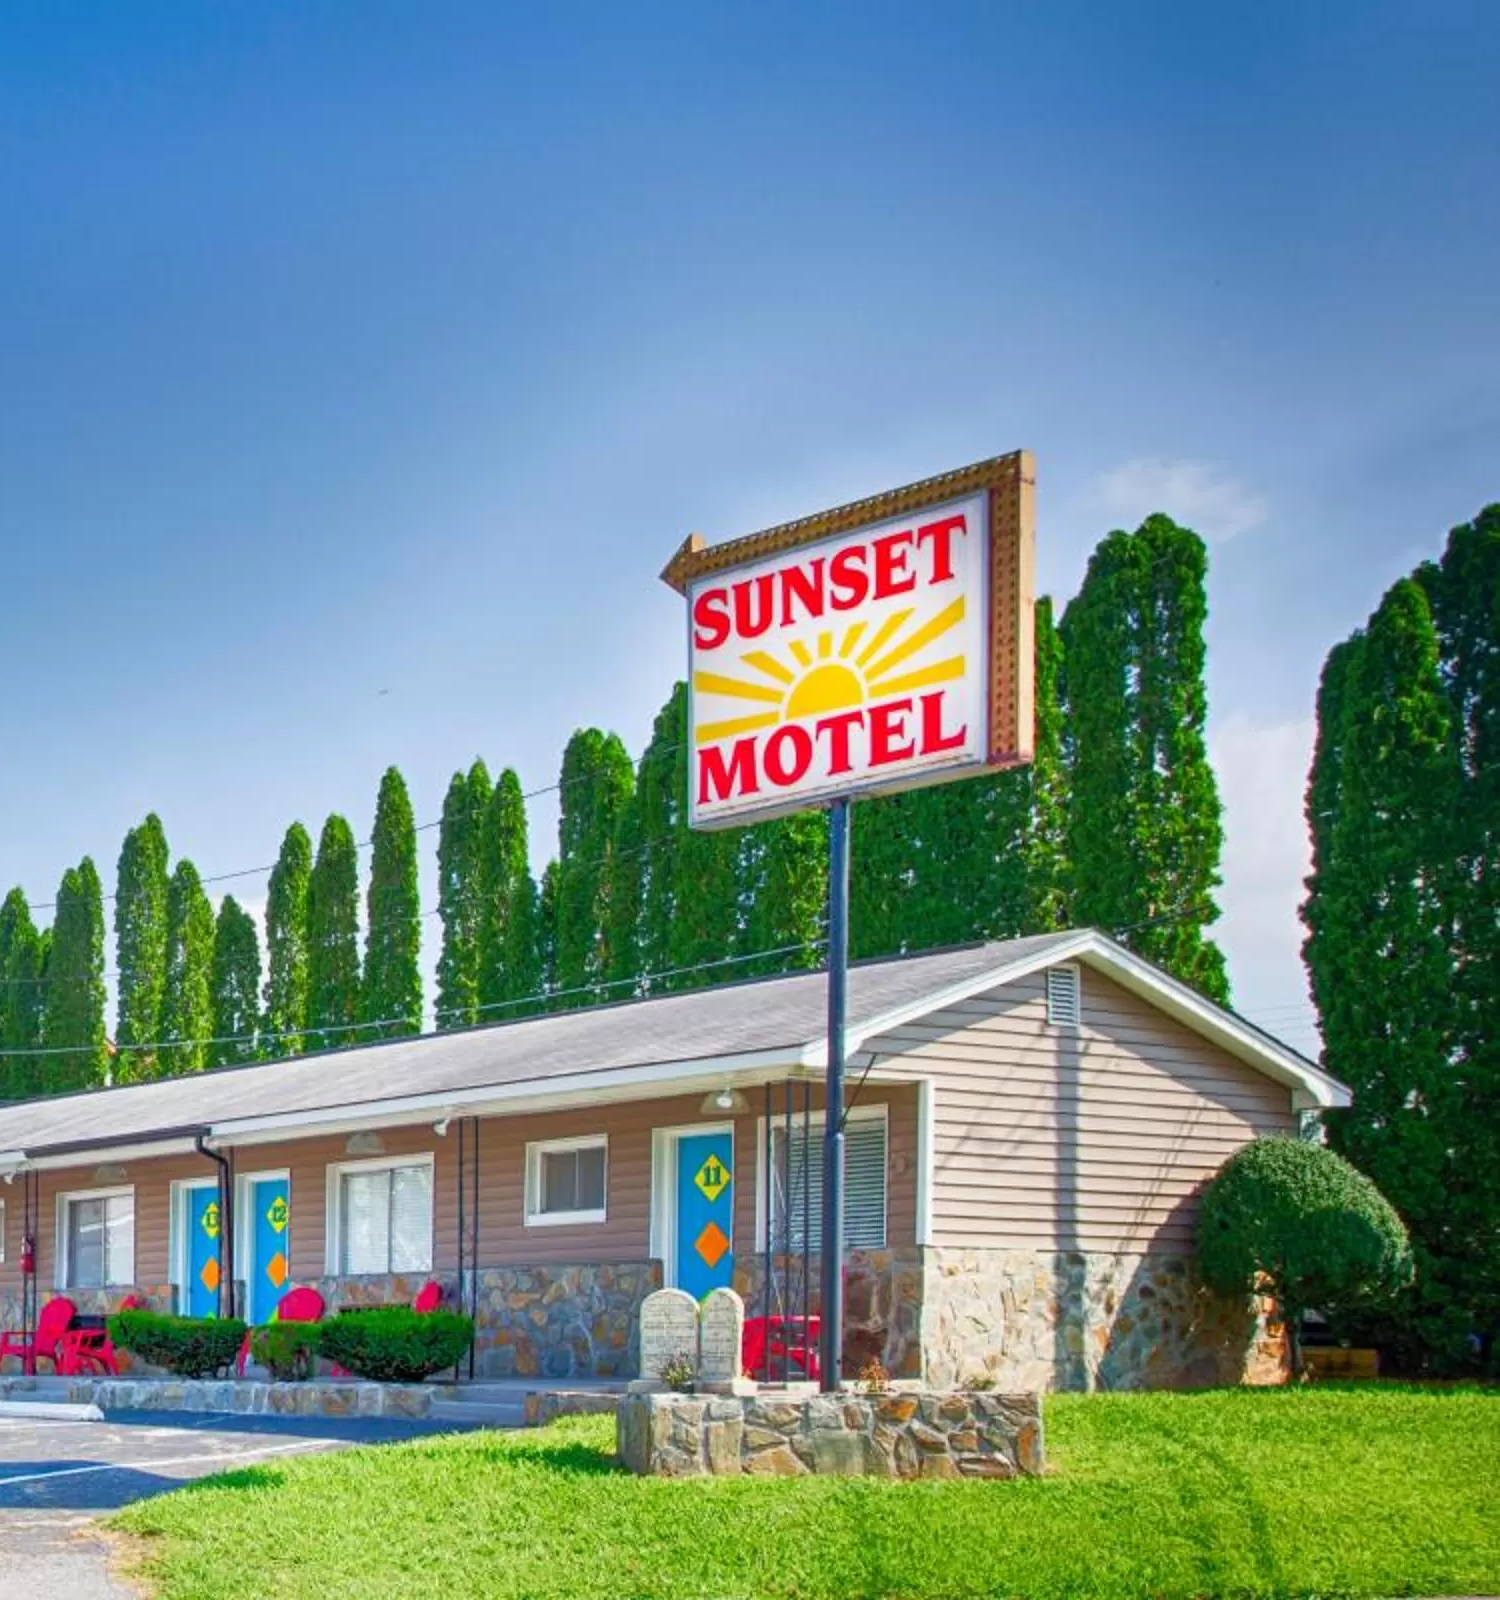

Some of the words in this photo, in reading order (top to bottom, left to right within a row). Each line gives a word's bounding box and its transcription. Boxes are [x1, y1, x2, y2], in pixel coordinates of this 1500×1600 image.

[693, 514, 967, 650] SUNSET
[696, 691, 967, 804] MOTEL
[703, 1166, 721, 1186] 11
